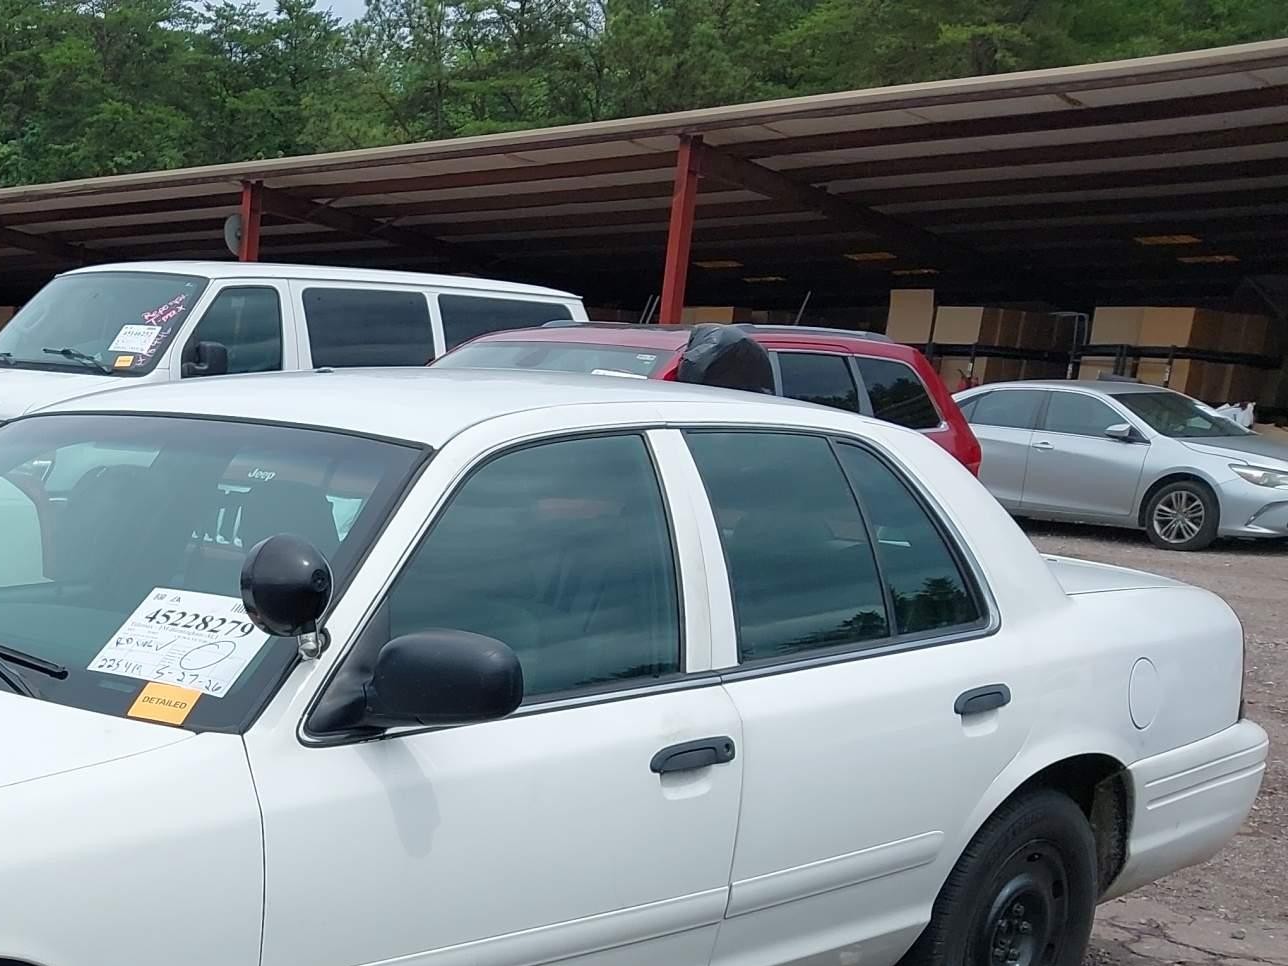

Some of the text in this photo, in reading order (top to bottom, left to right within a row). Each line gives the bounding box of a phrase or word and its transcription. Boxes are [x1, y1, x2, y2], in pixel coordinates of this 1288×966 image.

[248, 468, 276, 482] Jeep
[144, 607, 255, 638] 45228279
[142, 695, 187, 710] DETAILED
